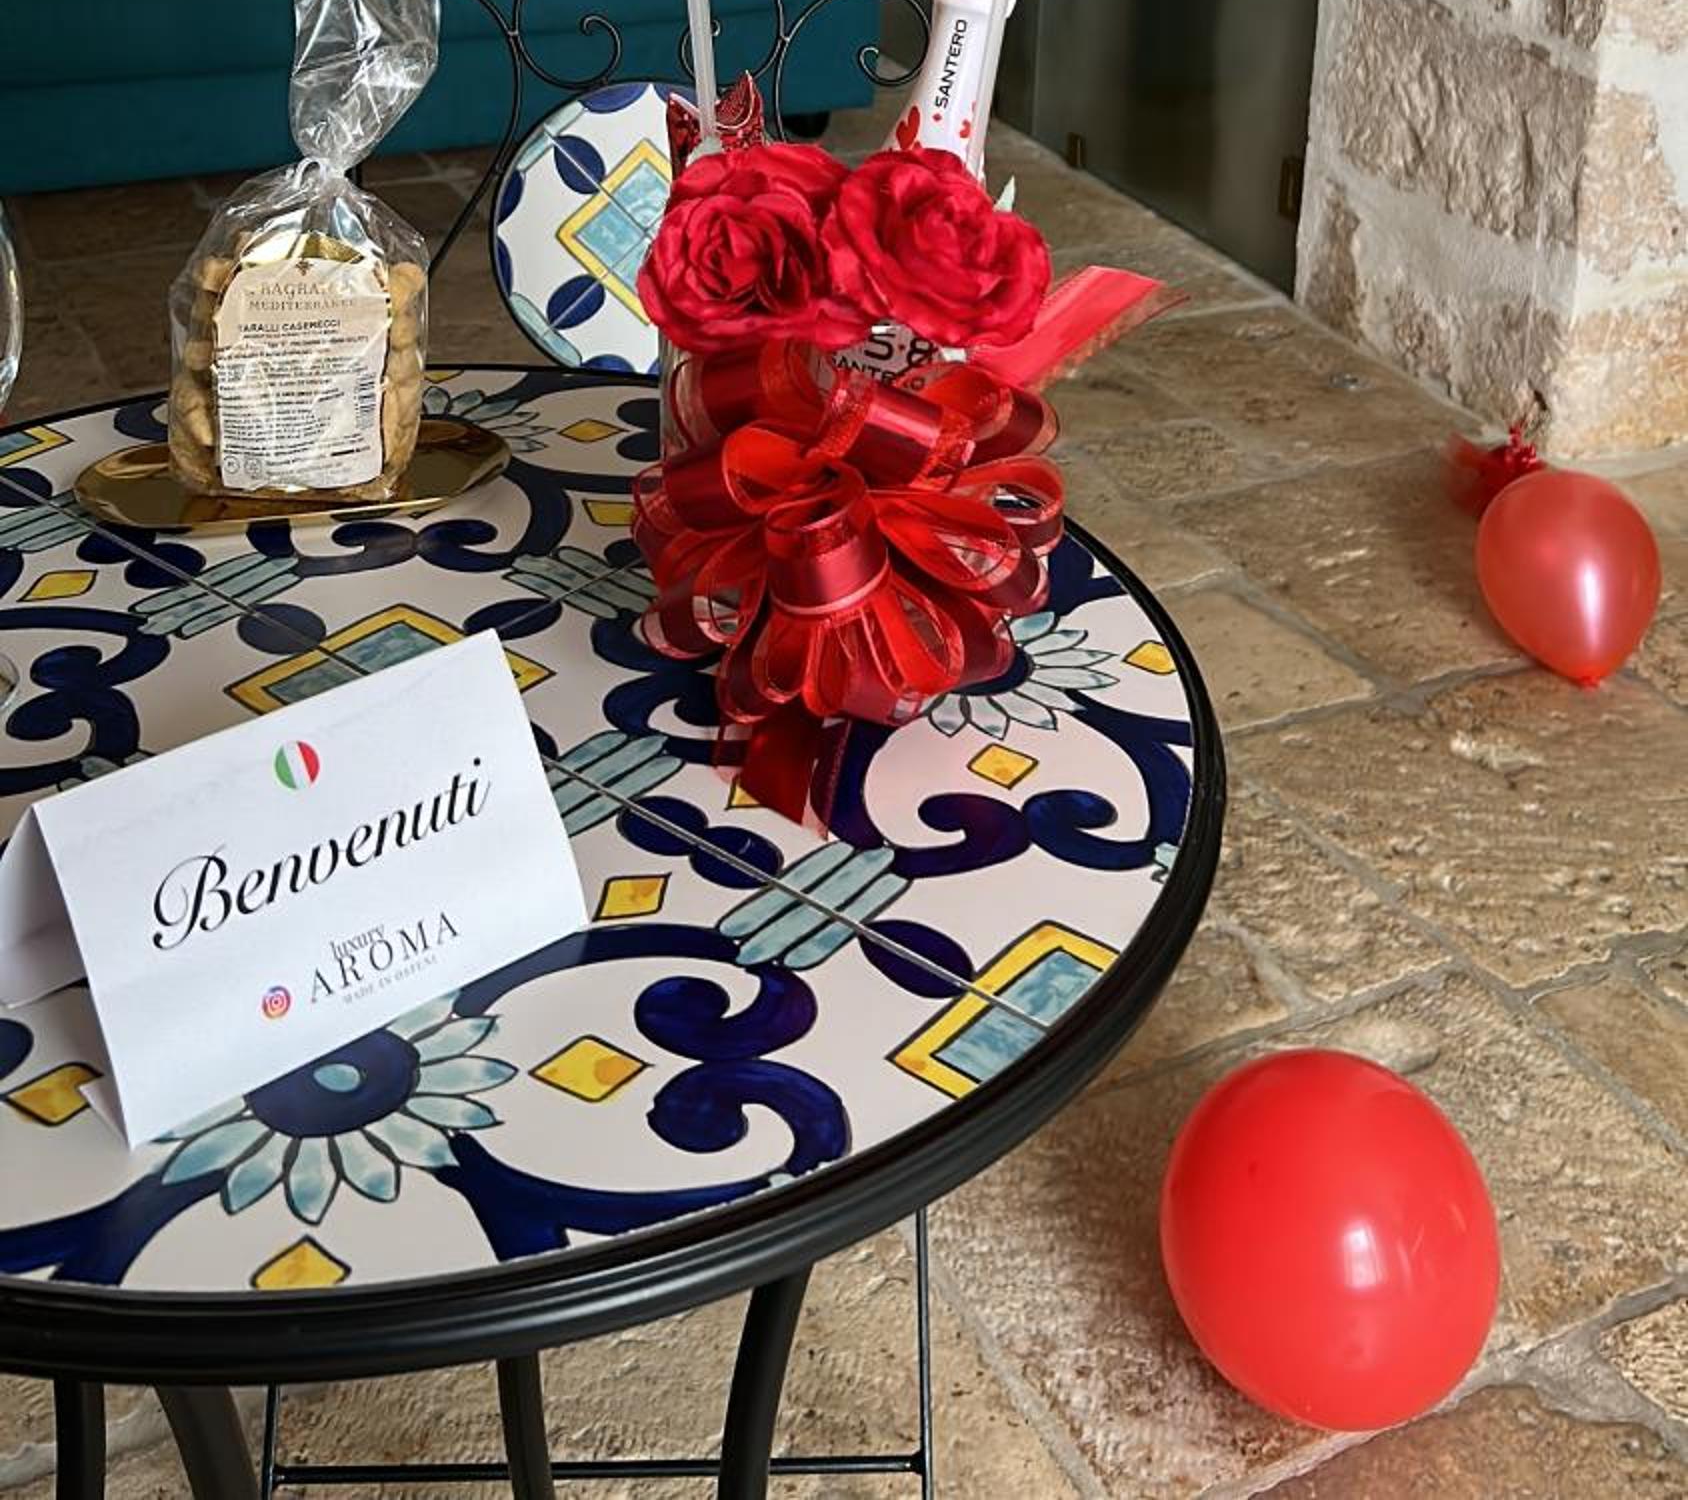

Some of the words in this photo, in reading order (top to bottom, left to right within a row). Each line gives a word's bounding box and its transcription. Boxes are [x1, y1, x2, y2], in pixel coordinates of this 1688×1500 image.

[934, 18, 968, 109] SANTERO
[152, 756, 492, 950] Benvenuti
[310, 911, 460, 1004] AROMA
[330, 924, 386, 963] luxury
